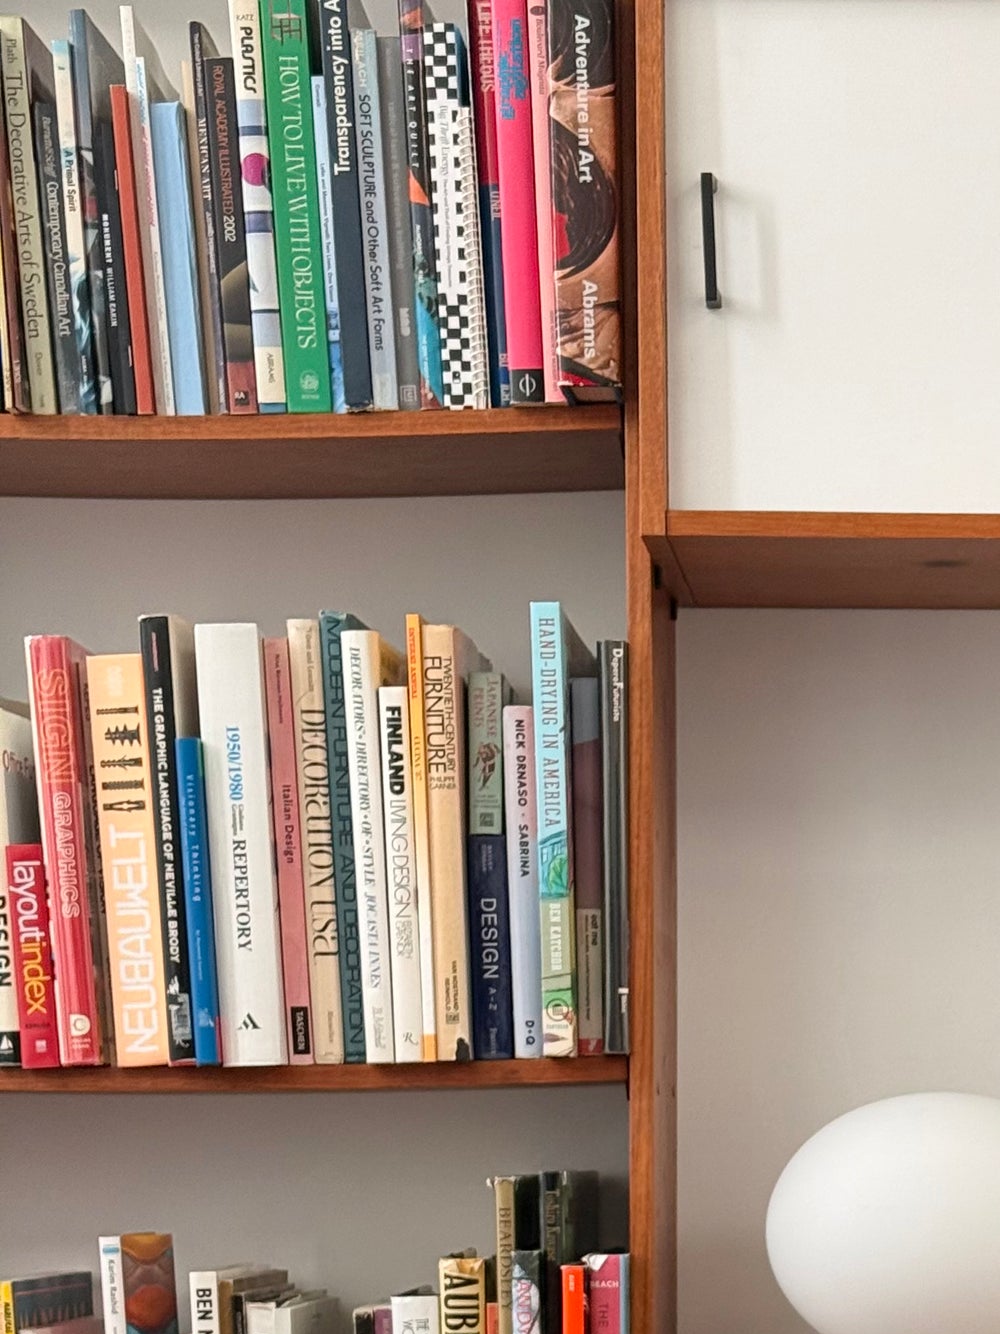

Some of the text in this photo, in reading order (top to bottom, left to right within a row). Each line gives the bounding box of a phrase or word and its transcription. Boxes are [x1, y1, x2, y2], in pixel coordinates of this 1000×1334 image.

[6, 38, 18, 64] Plath
[240, 27, 257, 93] PLASTICS
[6, 71, 23, 106] The
[406, 48, 419, 168] THE ART QUILT
[9, 112, 29, 205] Decorative
[64, 150, 77, 212] A Primal Spirit
[198, 117, 212, 201] MEXICAN ART
[213, 66, 236, 242] ROYAL ACADEMY ILLUSTRATED 2002
[439, 147, 450, 176] Energy
[575, 14, 598, 359] Adventure in Art Abrams
[18, 210, 35, 245] Arts
[102, 213, 113, 263] MONUMENT
[279, 56, 317, 348] HOW TO LIVE WITH OBJECTS
[359, 94, 386, 351] SOFT SCULPTURE and Other Soft Art Forms
[22, 250, 39, 268] of
[46, 182, 71, 336] Contemporary Canadian Art
[107, 267, 116, 301] WILLIAM
[24, 273, 43, 339] Sweden
[424, 656, 447, 774] FURNITURE
[442, 656, 456, 772] TWENTIETH-CENTURY
[472, 687, 485, 728] PRINTS
[486, 680, 499, 737] JAPANESE
[538, 618, 562, 828] HAND-DRYING IN AMERICA
[37, 669, 79, 919] SIGN GRAPHICS
[226, 725, 244, 801] 1950/1980
[515, 719, 530, 878] NICK DRNASO SABRINA
[152, 688, 180, 964] THE GRAPHIC LANGUAGE OF NEVILLE BRODY
[186, 774, 203, 902] Visionary Thinking
[282, 784, 296, 863] Italian Design
[326, 619, 365, 1044] MODERN FURNITURE AND DECORATION
[386, 706, 412, 918] FINLAND LIVING DESIGN
[233, 839, 252, 953] REPERTORY
[591, 914, 600, 946] eat me
[110, 824, 159, 1053] NEUBAUWELT
[550, 903, 563, 971] BEN KATCHOR
[295, 1010, 306, 1051] TASCHEN
[108, 1259, 120, 1284] Karim
[109, 1286, 120, 1315] Rashid
[196, 1288, 214, 1321] BEN
[515, 1280, 534, 1334] ANDY
[416, 1318, 430, 1331] THE
[598, 1303, 610, 1327] THE
